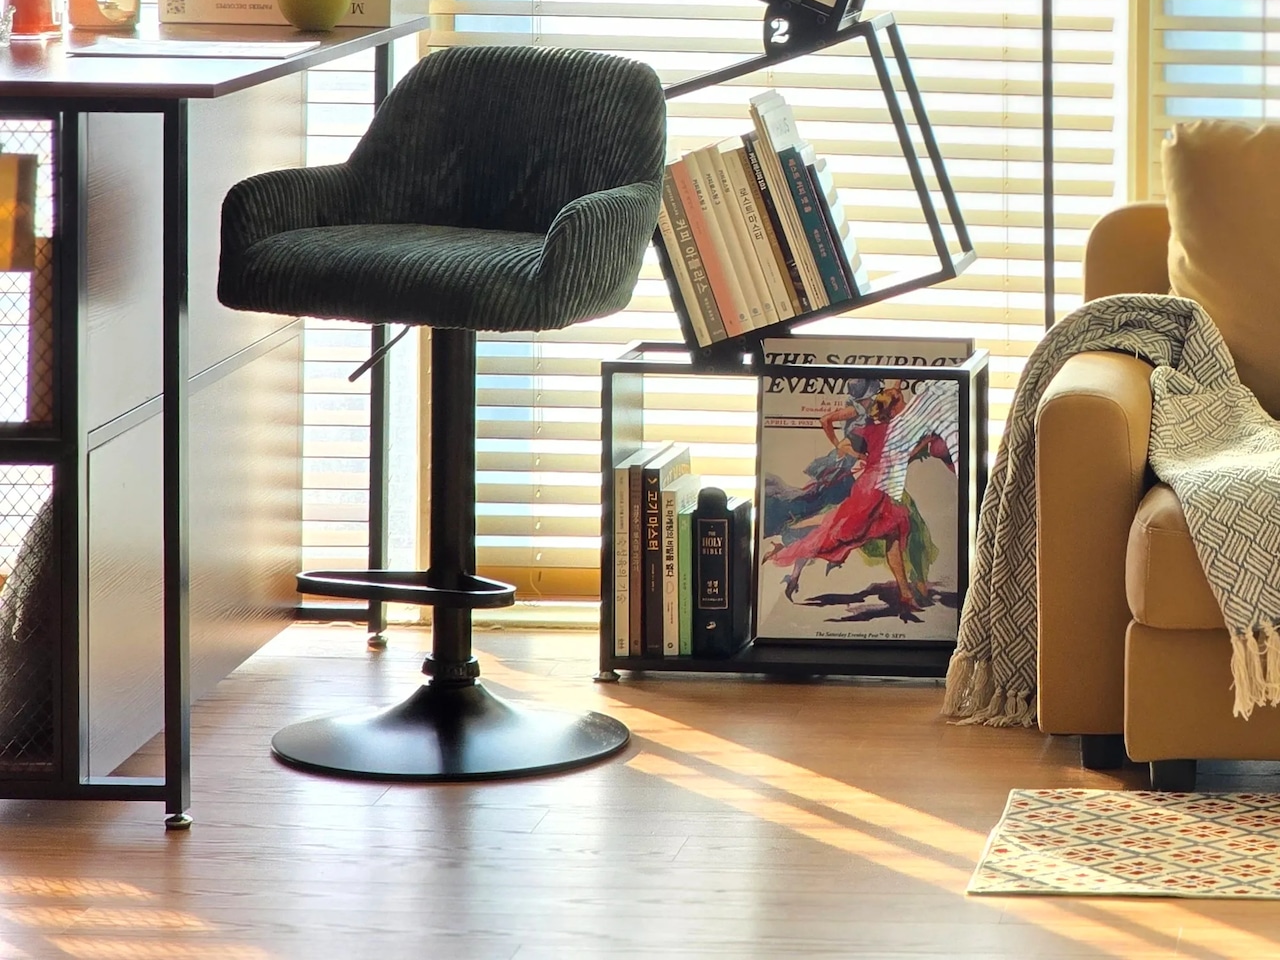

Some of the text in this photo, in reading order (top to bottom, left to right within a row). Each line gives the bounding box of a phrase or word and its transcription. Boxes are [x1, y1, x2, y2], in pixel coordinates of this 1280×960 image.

[770, 18, 789, 43] 2
[673, 217, 691, 243] 커피
[683, 245, 709, 295] 아틀라스
[646, 490, 658, 550] 고기 마스터
[703, 538, 722, 547] HOLY
